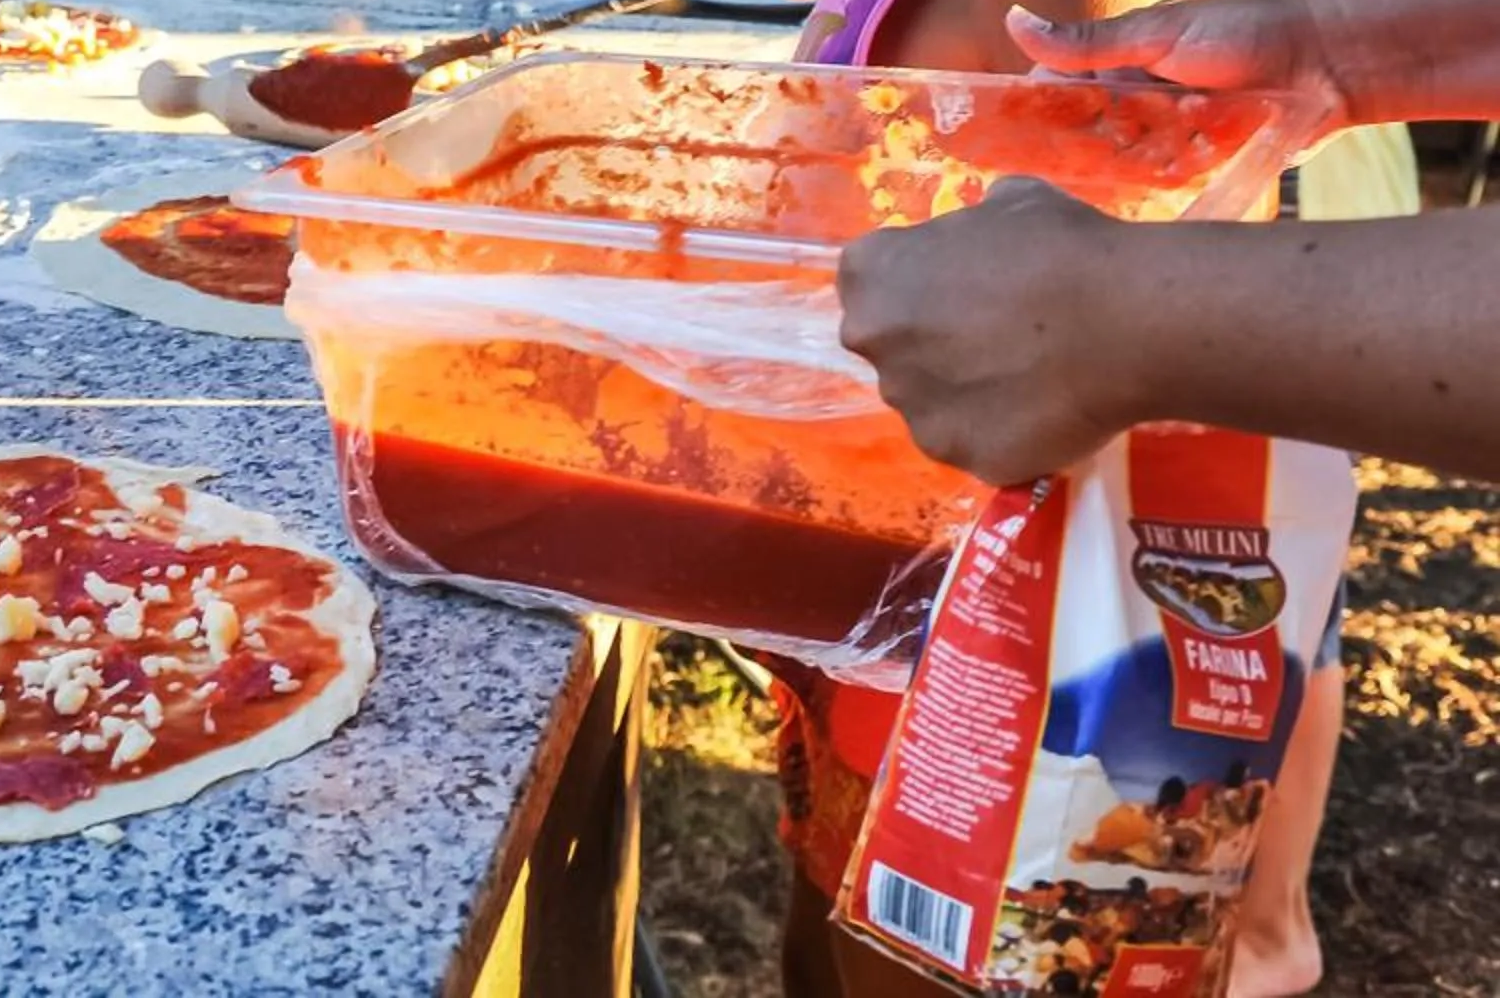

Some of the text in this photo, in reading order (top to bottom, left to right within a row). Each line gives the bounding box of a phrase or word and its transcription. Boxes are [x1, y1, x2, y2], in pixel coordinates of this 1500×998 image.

[1141, 523, 1262, 556] TRE MULINI
[1184, 638, 1267, 681] FARINA
